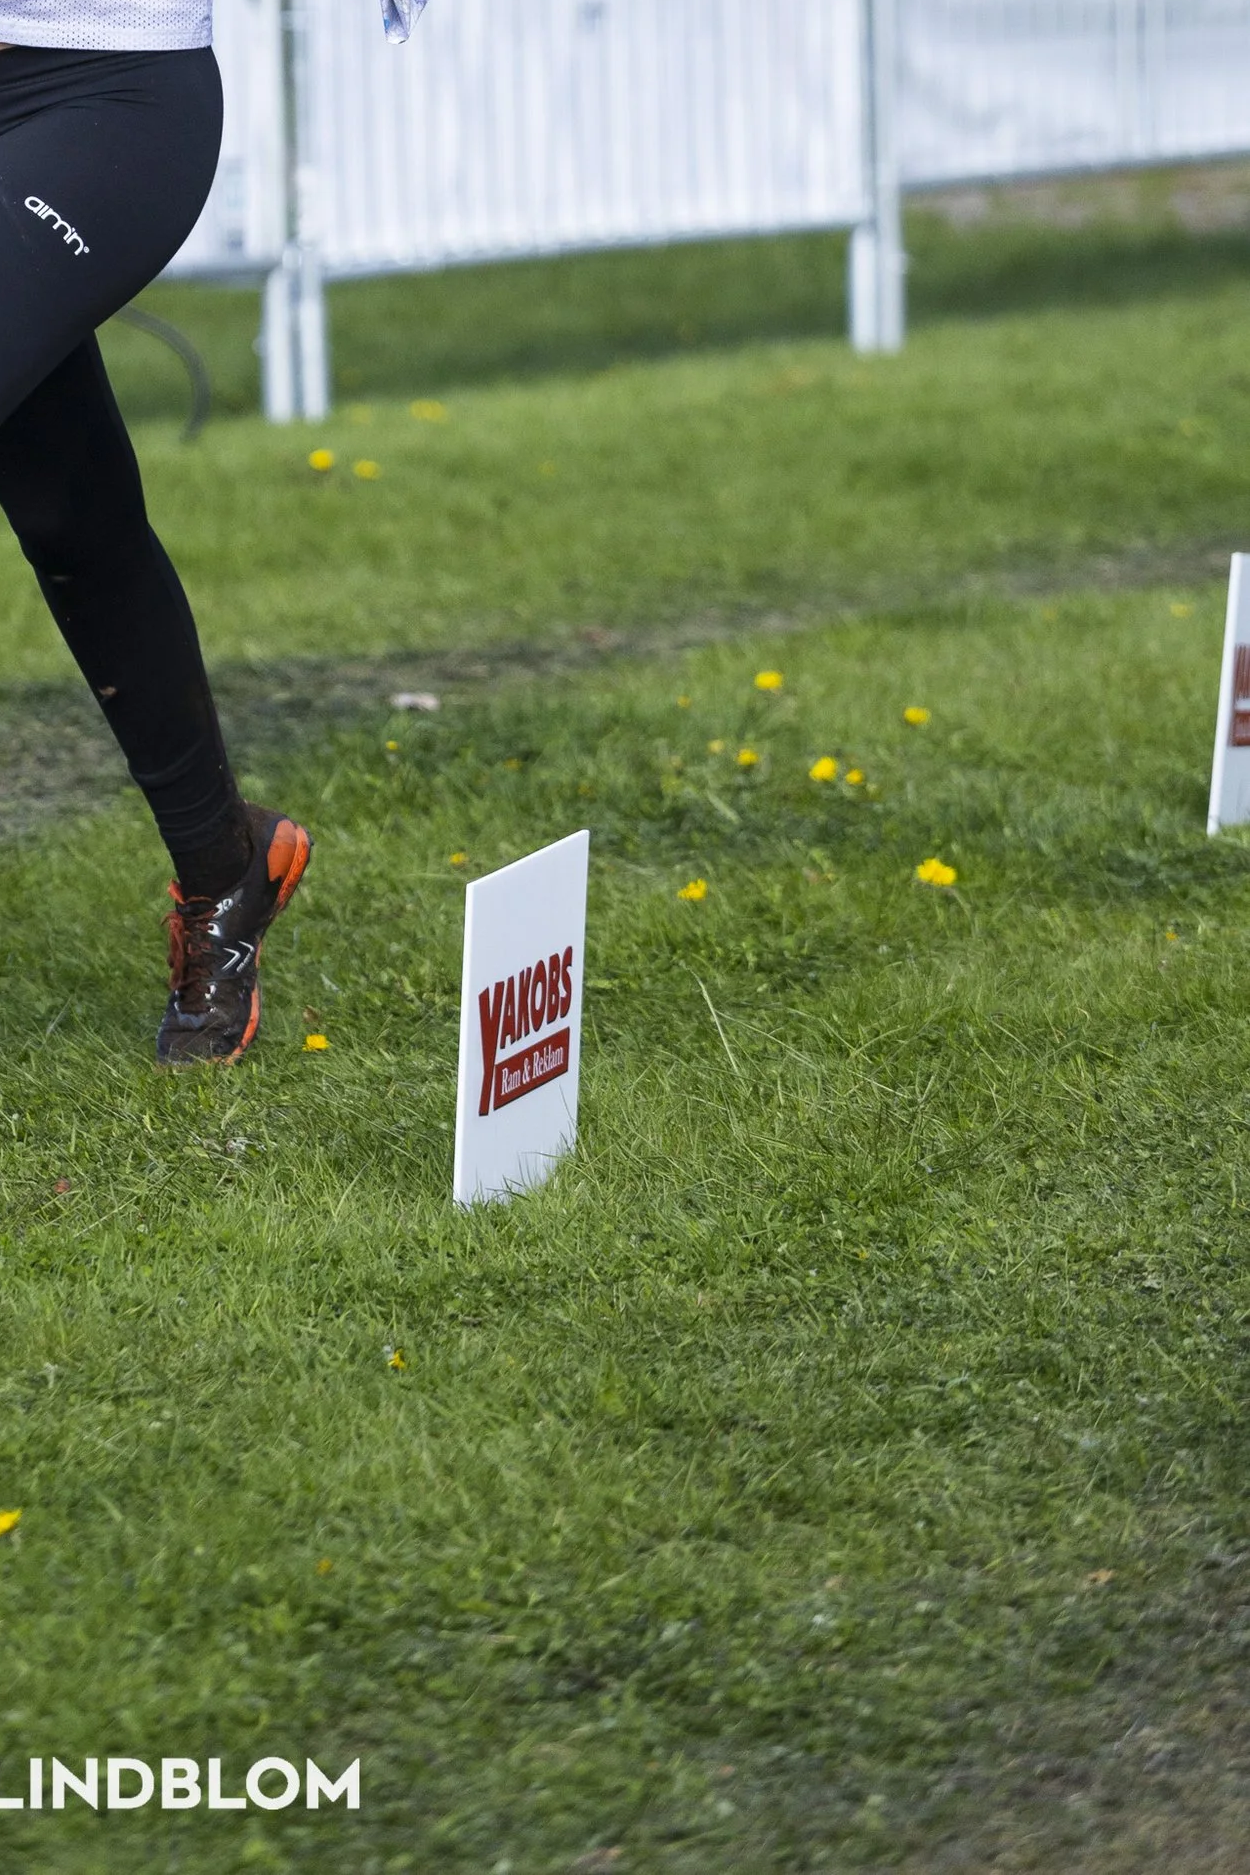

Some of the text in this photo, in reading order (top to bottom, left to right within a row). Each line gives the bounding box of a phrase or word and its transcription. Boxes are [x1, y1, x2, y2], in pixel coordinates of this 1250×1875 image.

[478, 945, 573, 1117] YAKOBS
[500, 1044, 564, 1096] Ram & Reklam
